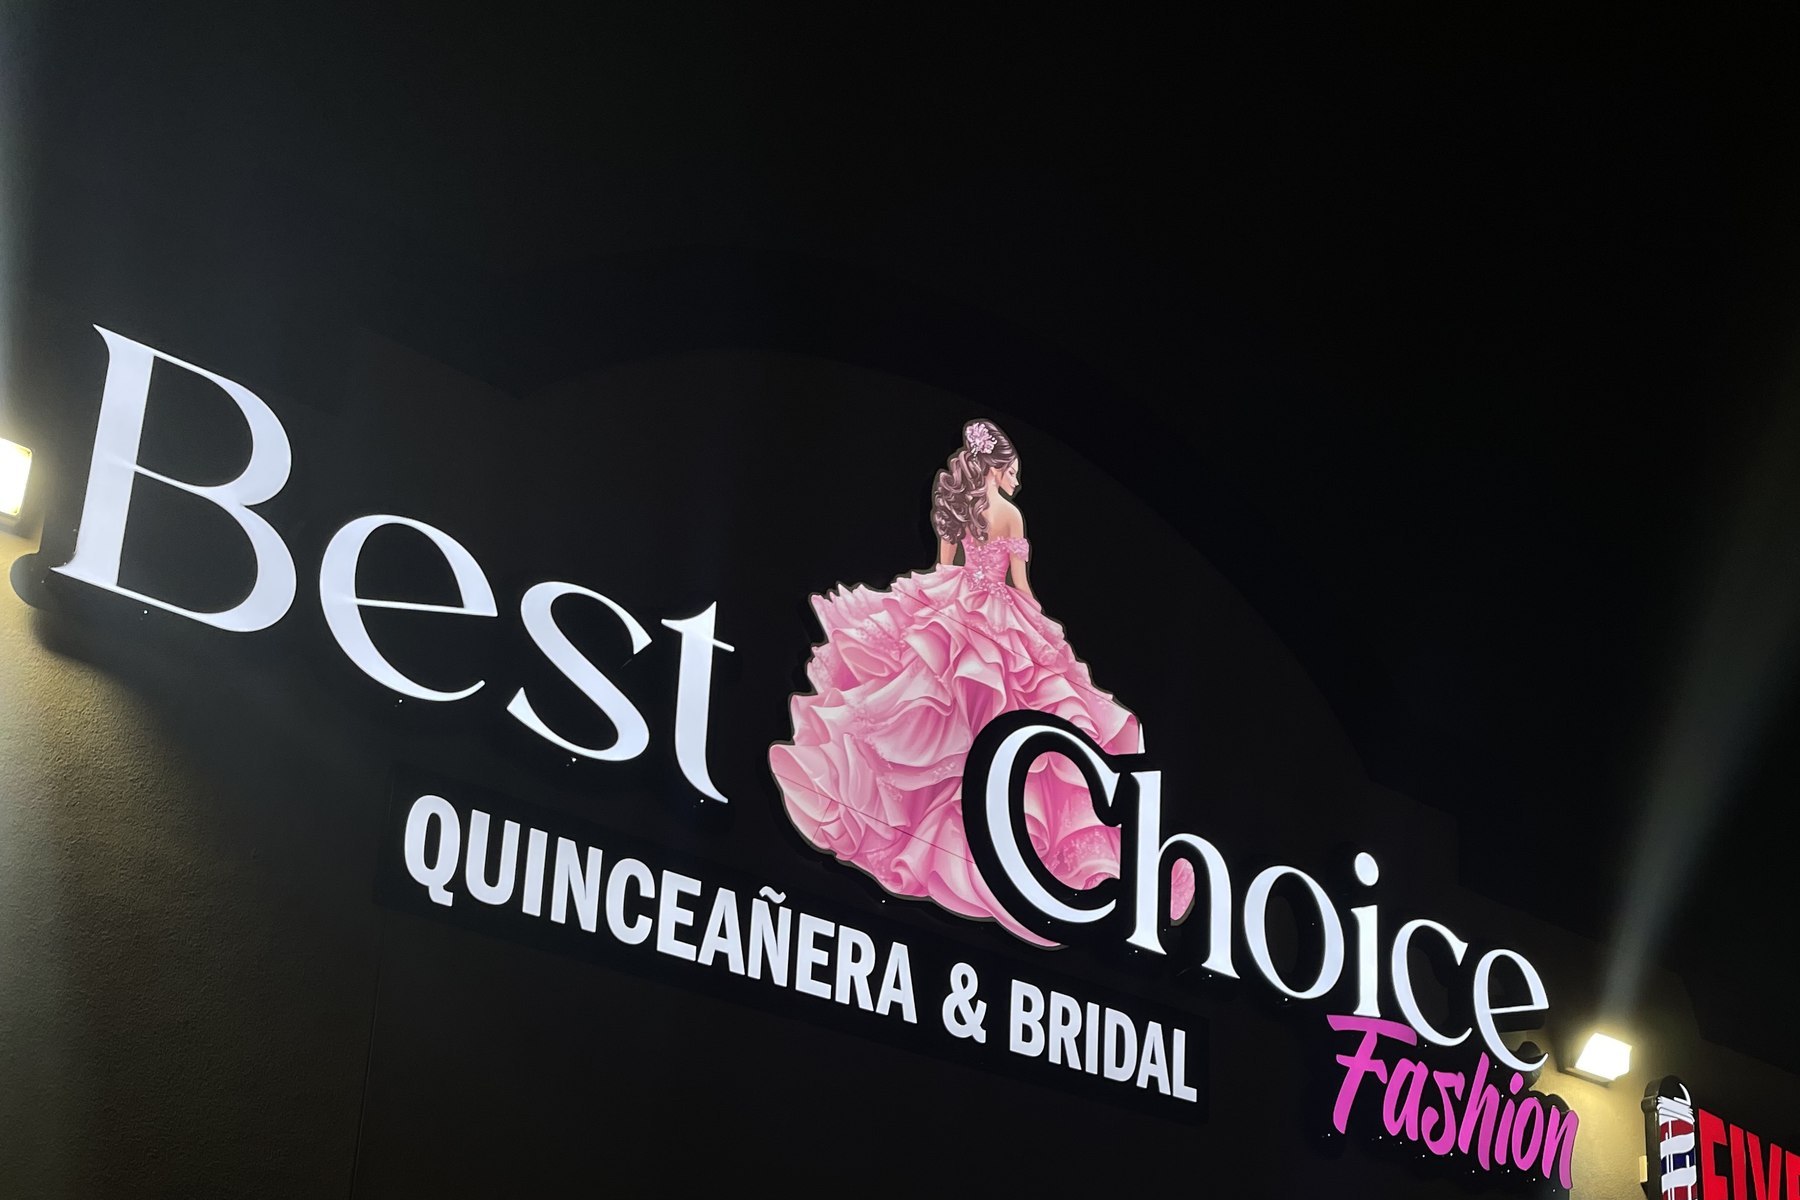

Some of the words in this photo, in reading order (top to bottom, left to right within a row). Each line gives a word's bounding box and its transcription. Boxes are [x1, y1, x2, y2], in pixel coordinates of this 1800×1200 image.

[49, 324, 735, 804] Best
[983, 722, 1550, 1072] Choice
[404, 794, 918, 1024] QUINCEAÑERA
[942, 962, 987, 1044] &
[1009, 978, 1198, 1103] BRIDAL
[1326, 1014, 1580, 1192] Fashion
